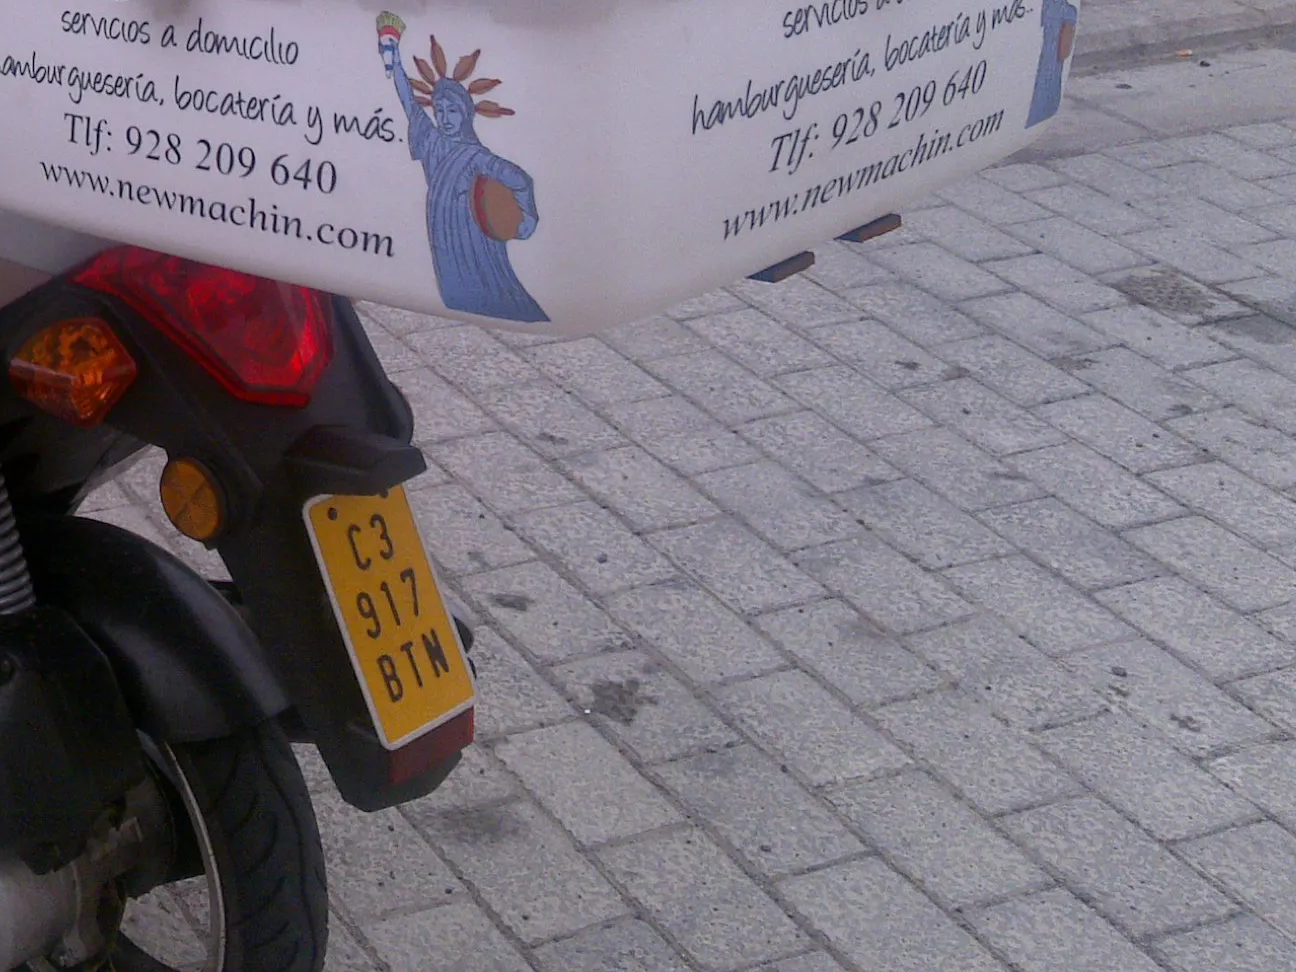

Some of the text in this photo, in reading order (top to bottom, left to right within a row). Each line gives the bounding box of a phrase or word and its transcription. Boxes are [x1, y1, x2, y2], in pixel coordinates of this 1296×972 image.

[60, 9, 299, 65] servicios a domicilio
[885, 11, 971, 71] bocatería
[972, 14, 987, 50] y
[174, 75, 297, 126] bocatería
[304, 106, 323, 145] y
[768, 60, 987, 175] Tlf: 928 209 640
[64, 113, 338, 195] Tlf: 928 209 640
[722, 109, 1005, 240] www.newmachin.com
[40, 161, 395, 258] www.newmachin.com
[347, 513, 394, 571] C3
[356, 568, 419, 639] 917
[376, 629, 450, 703] BTN
